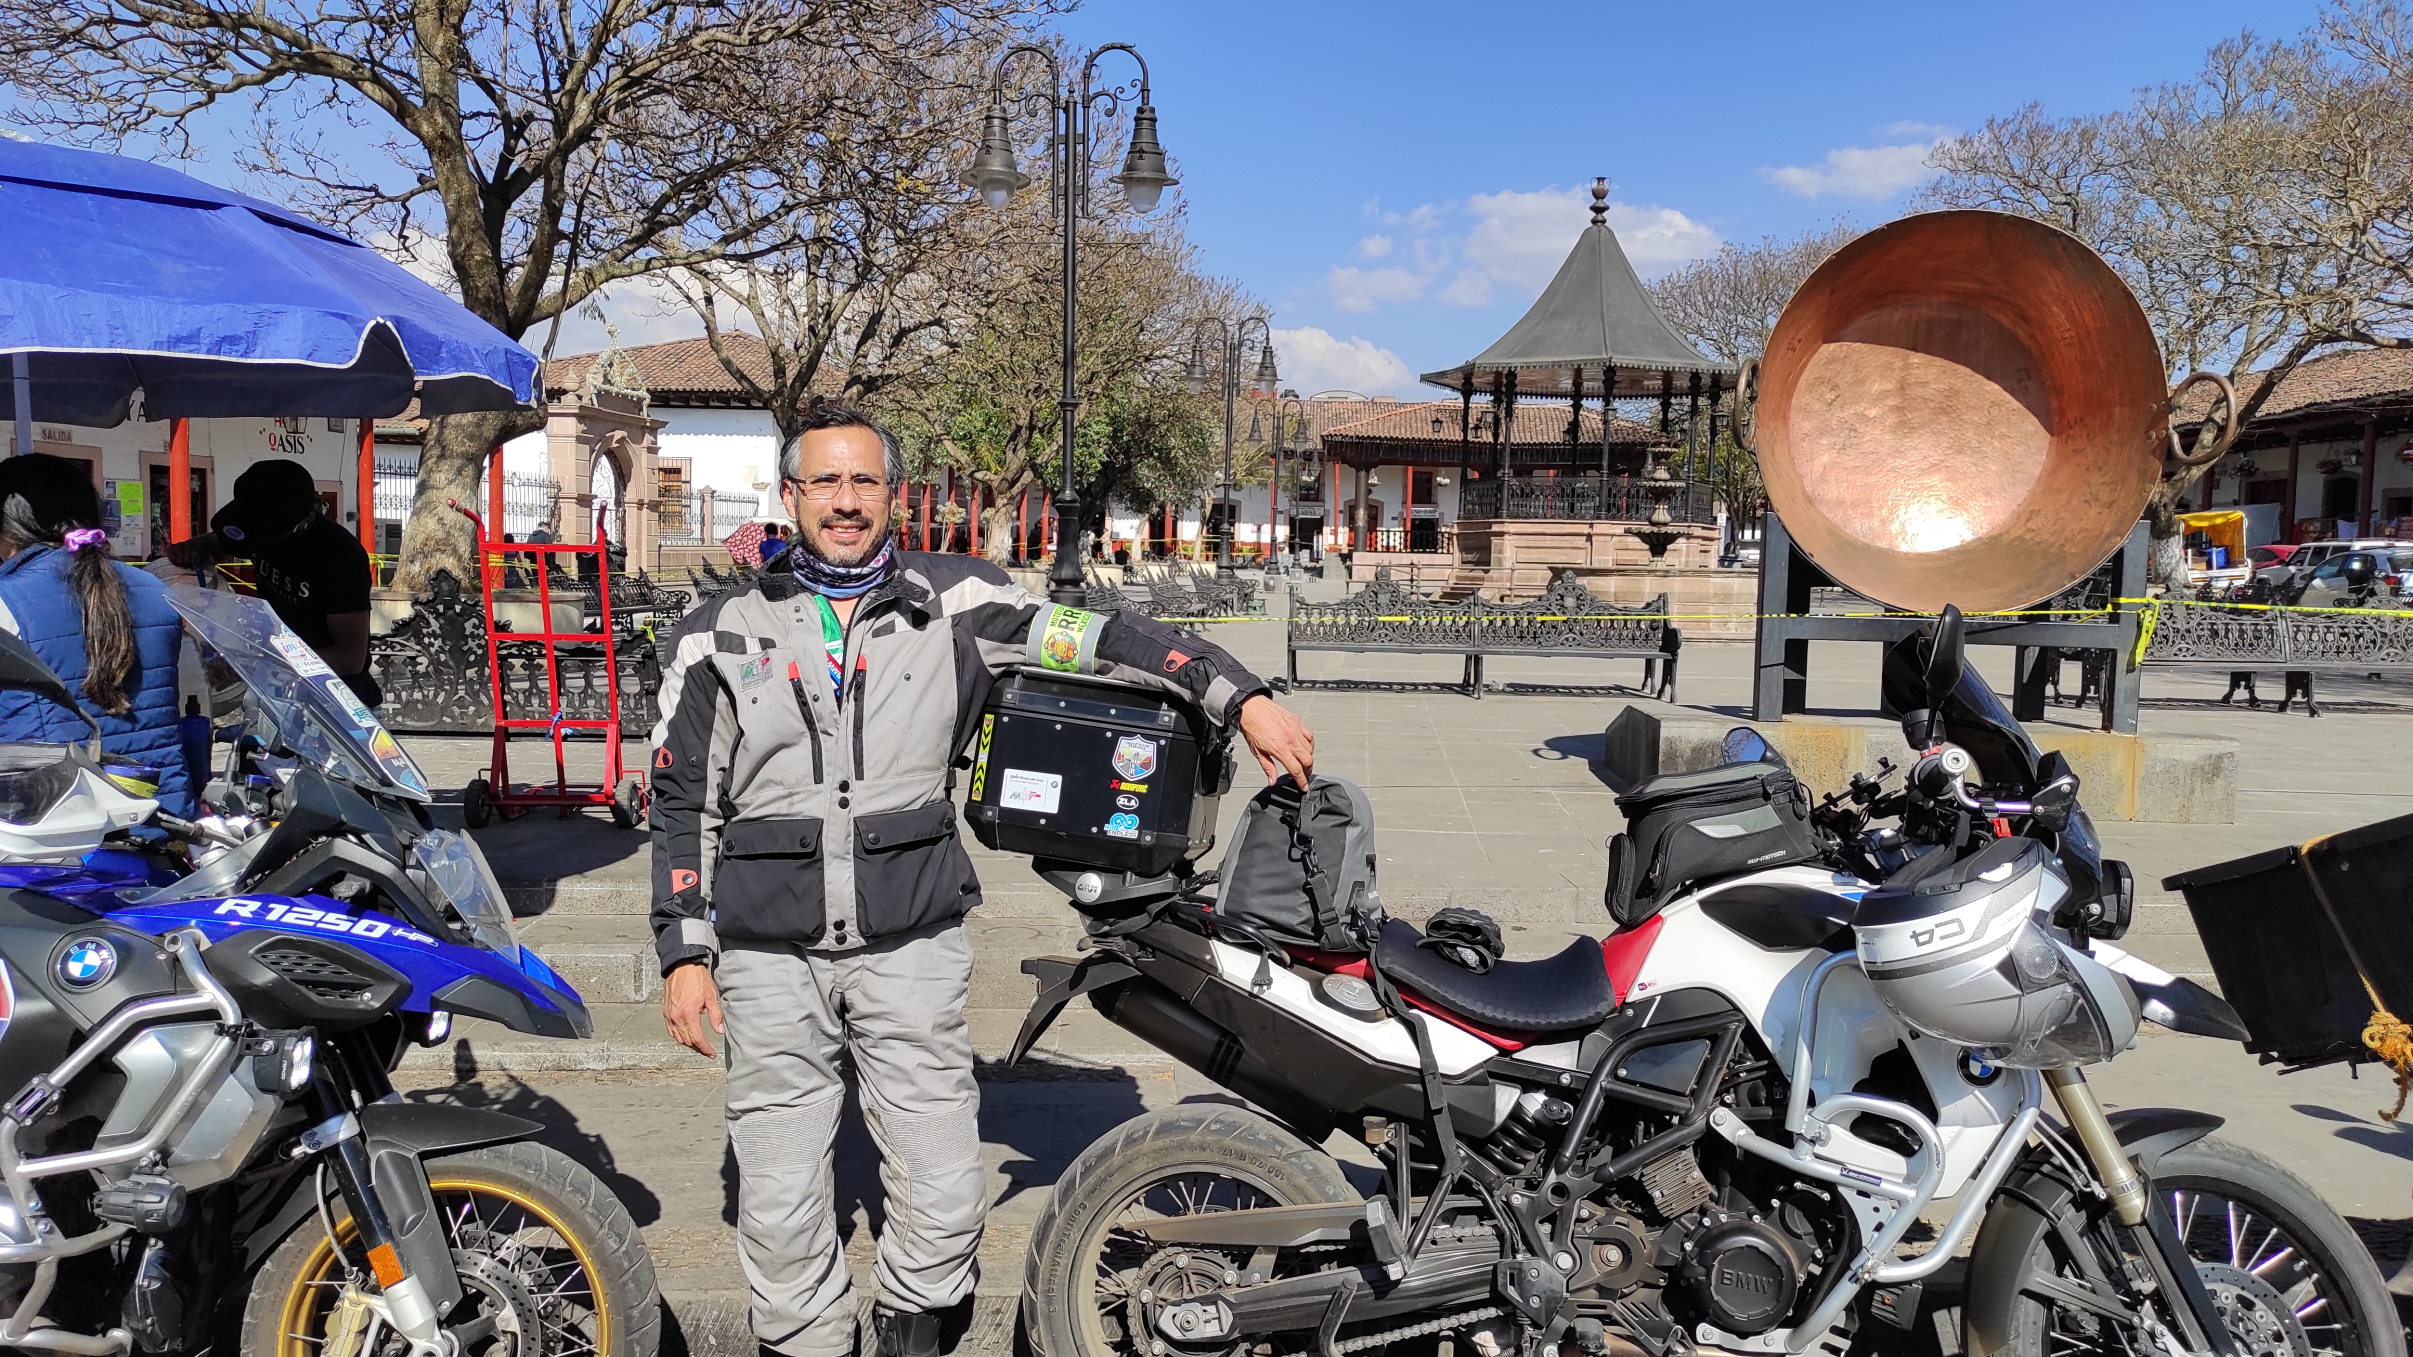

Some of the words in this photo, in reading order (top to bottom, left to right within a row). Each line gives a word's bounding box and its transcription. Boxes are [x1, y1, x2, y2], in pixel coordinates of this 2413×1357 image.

[41, 428, 73, 443] SALIDA
[1118, 797, 1137, 807] ZLA
[1106, 828, 1138, 839] ENDLESS
[213, 898, 262, 918] R
[264, 902, 392, 939] 1250
[69, 942, 111, 960] BMW
[1720, 1268, 1774, 1294] BMW
